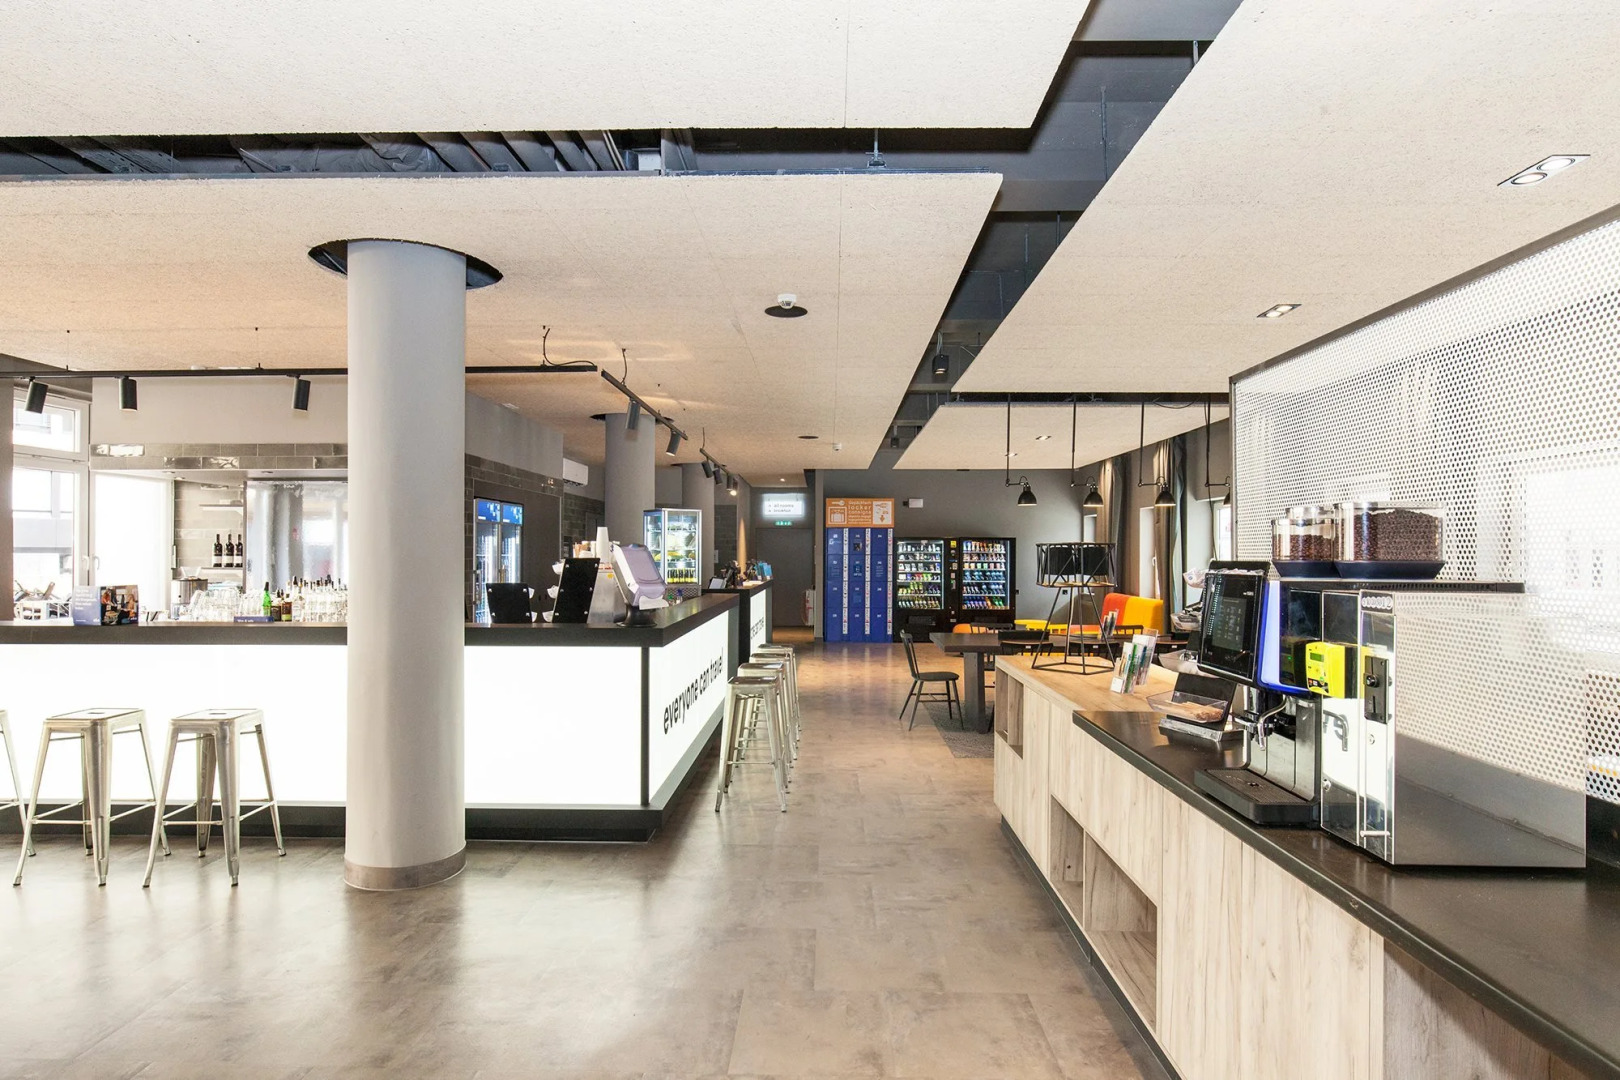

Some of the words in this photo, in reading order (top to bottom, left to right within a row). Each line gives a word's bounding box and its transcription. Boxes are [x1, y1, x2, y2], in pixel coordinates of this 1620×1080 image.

[664, 678, 698, 735] everyone
[700, 668, 709, 695] can
[710, 647, 724, 684] travel
